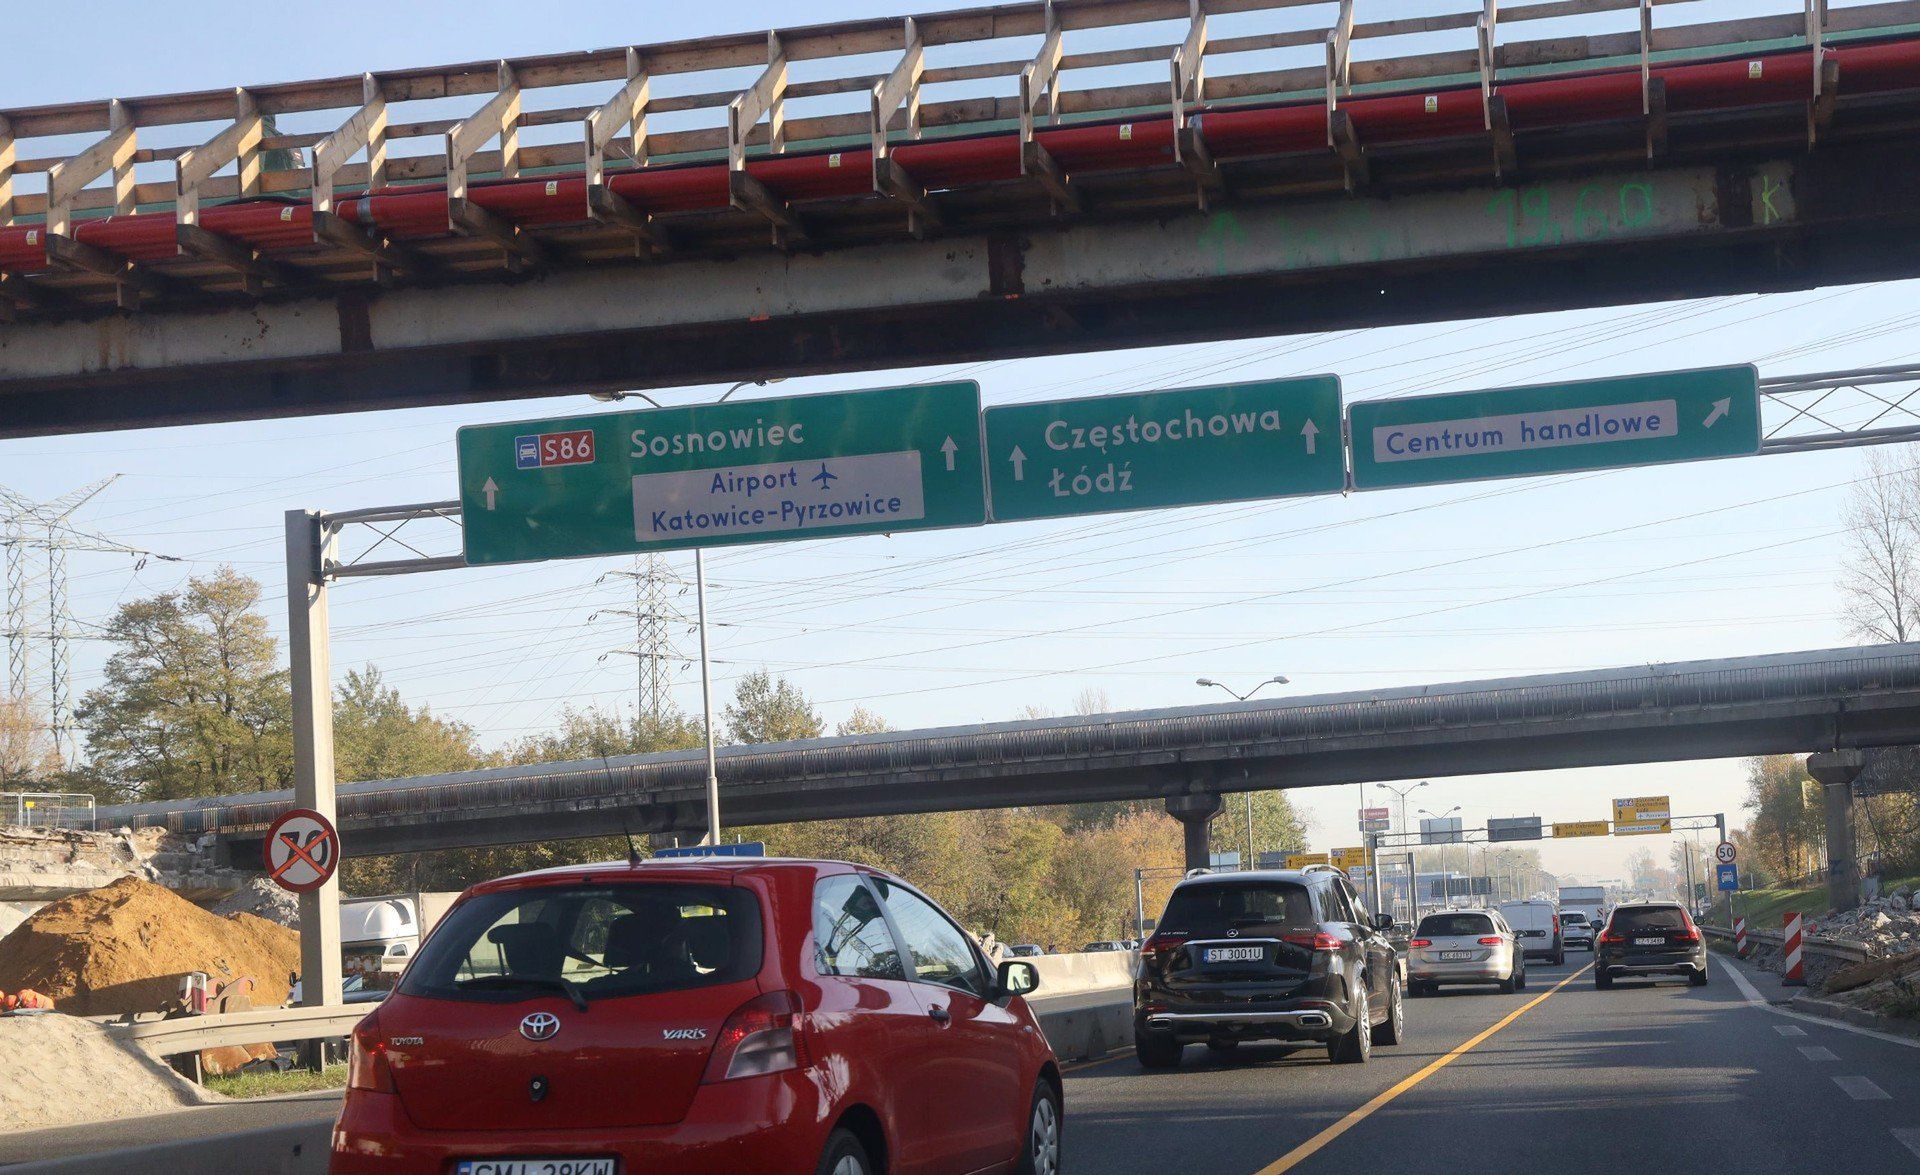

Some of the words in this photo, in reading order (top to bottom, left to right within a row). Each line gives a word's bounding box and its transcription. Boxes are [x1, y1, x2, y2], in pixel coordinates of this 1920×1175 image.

[544, 435, 591, 462] S86
[630, 419, 805, 458] Sosnowiec
[1044, 408, 1281, 455] Częstochowa
[1386, 427, 1504, 455] Centrum
[1520, 413, 1661, 444] handlowe
[710, 466, 798, 498] Airport
[1048, 461, 1133, 498] Łódź
[651, 493, 902, 533] Katowice-Pyrzowice
[1719, 847, 1734, 859] 50
[1210, 949, 1223, 960] ST
[1228, 948, 1261, 960] 3001U
[390, 1036, 424, 1046] TOYOTA
